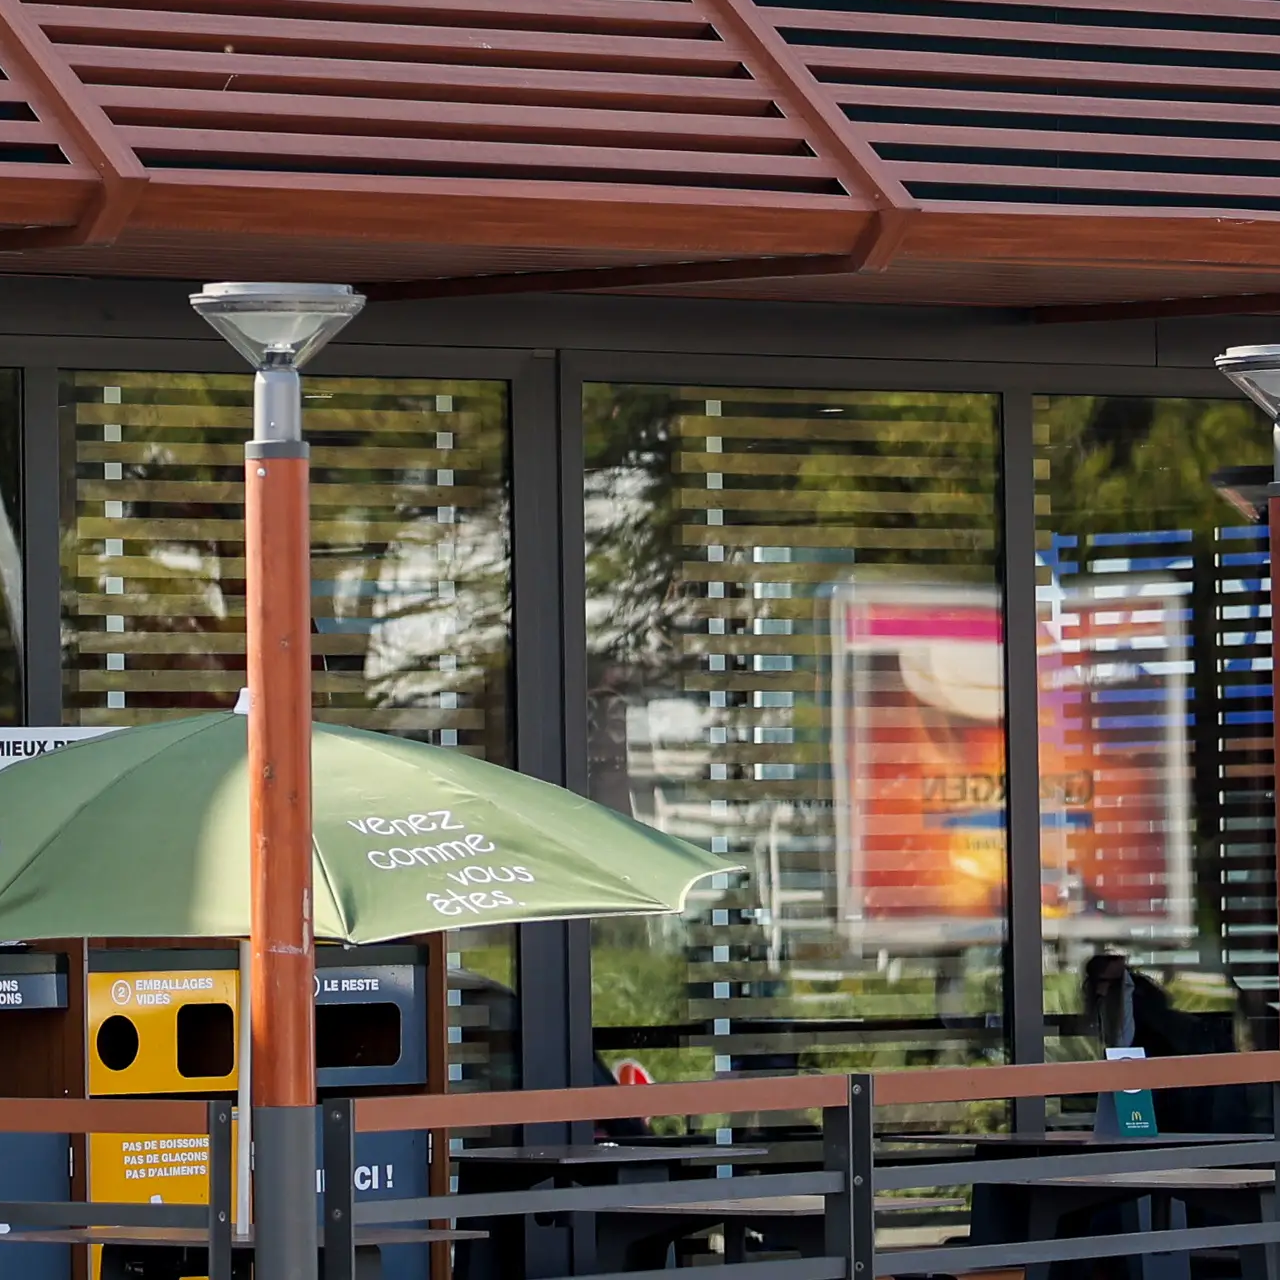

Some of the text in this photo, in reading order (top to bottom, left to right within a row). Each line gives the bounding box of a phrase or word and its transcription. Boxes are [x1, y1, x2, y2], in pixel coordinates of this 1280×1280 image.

[347, 810, 465, 837] venez
[368, 833, 495, 869] comme
[446, 865, 535, 886] vous
[426, 888, 526, 916] êtes.
[135, 977, 213, 991] EMBALLAGES
[323, 978, 380, 992] LE RESTE
[135, 993, 171, 1005] VIDES
[122, 1137, 209, 1151] PAS DE BOISSONS
[124, 1151, 208, 1165] PAS DE GLAÇONS
[125, 1164, 206, 1179] PAS D'ALIMENTS
